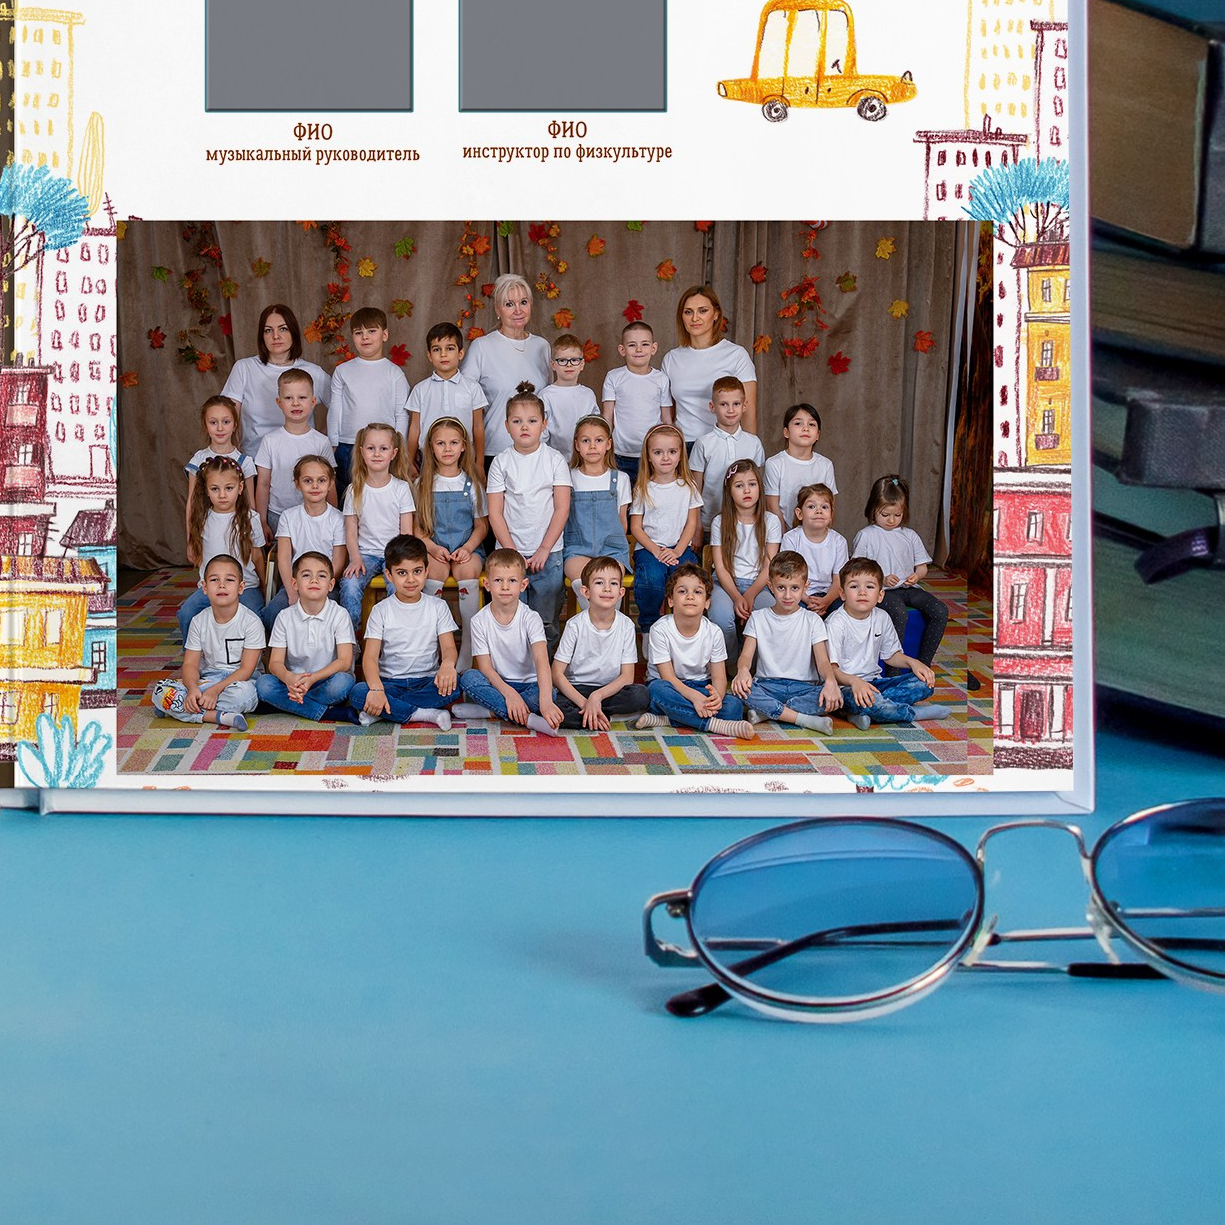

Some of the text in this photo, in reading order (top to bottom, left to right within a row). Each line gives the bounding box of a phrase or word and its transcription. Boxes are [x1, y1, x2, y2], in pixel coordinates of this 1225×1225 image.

[293, 121, 334, 142] ФИО
[547, 119, 588, 140] ФИО
[205, 146, 421, 166] музыкальный руководитель
[462, 143, 673, 164] инструктор по физкультуре
